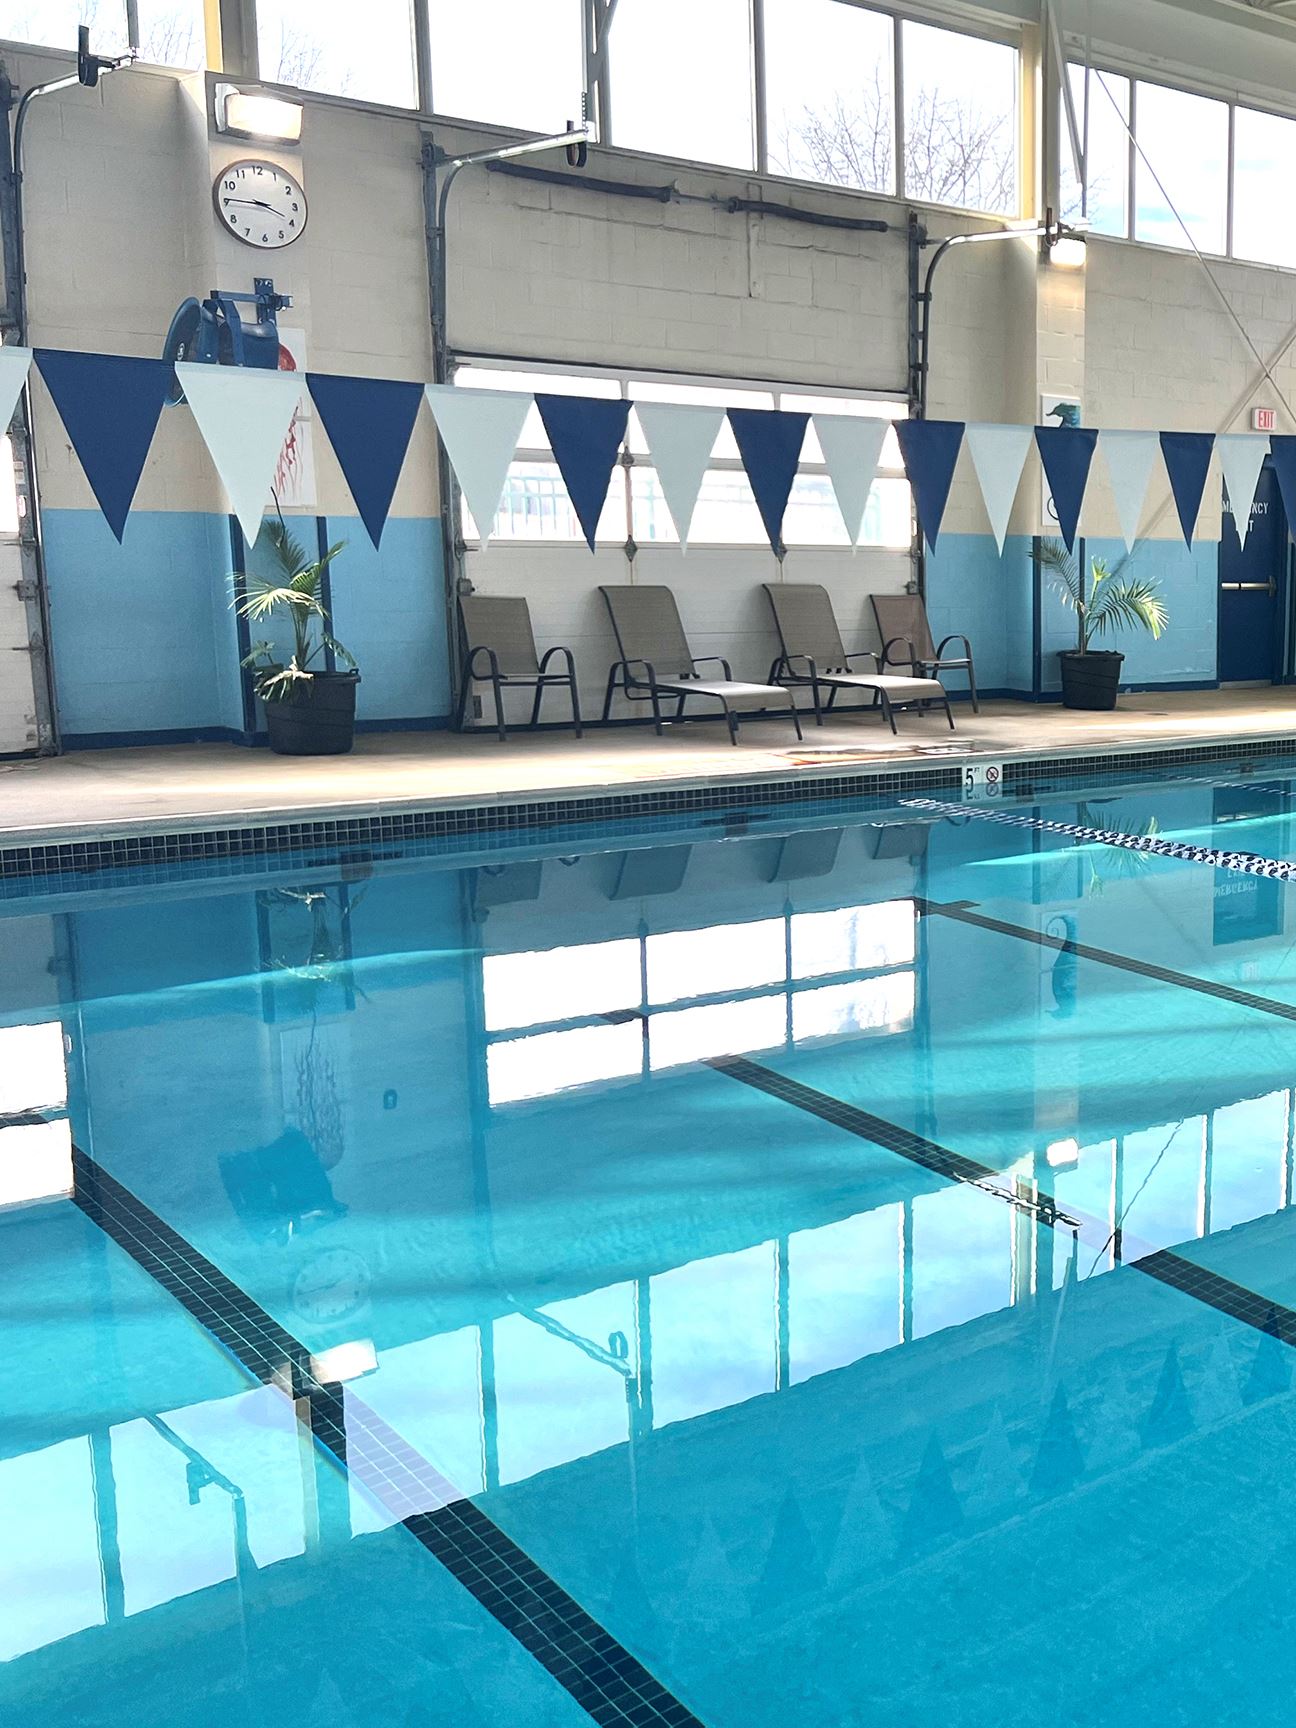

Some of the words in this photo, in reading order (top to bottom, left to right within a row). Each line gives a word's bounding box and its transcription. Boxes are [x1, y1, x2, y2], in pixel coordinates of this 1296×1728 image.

[236, 169, 245, 179] 11
[252, 165, 263, 176] 12
[273, 172, 277, 182] 1
[224, 180, 236, 190] 10
[285, 186, 292, 195] 2
[292, 203, 298, 212] 3
[230, 214, 237, 224] 8
[288, 219, 295, 227] 4
[245, 227, 251, 236] 7
[278, 230, 284, 239] 5
[262, 234, 268, 243] 6
[1258, 410, 1274, 429] EXIT
[965, 768, 974, 785] 5
